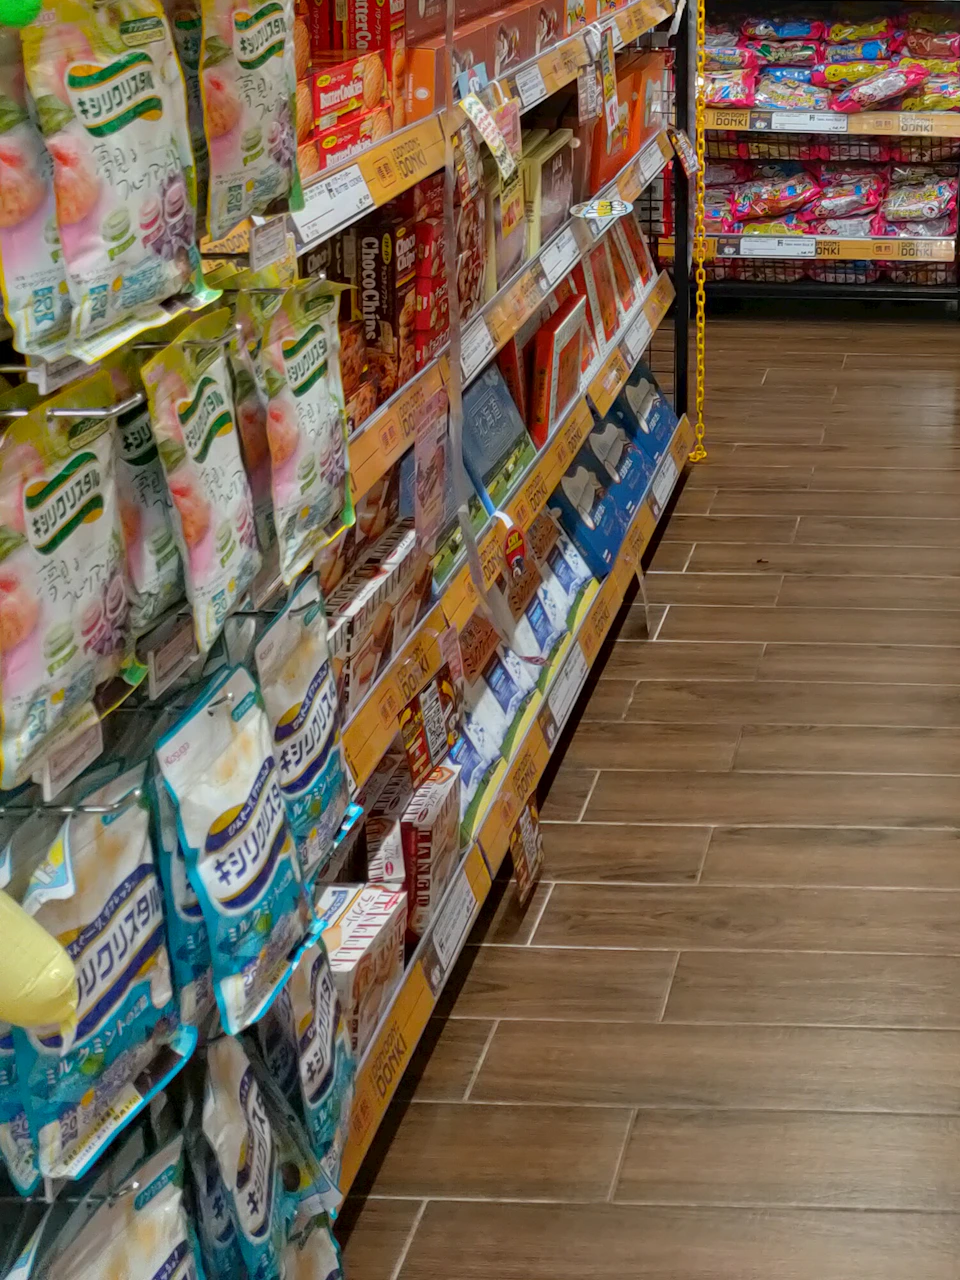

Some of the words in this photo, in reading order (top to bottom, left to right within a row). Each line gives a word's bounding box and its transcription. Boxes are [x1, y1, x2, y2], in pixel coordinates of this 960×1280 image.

[816, 246, 841, 255] ONKI
[32, 471, 100, 540] キシリクリスタル
